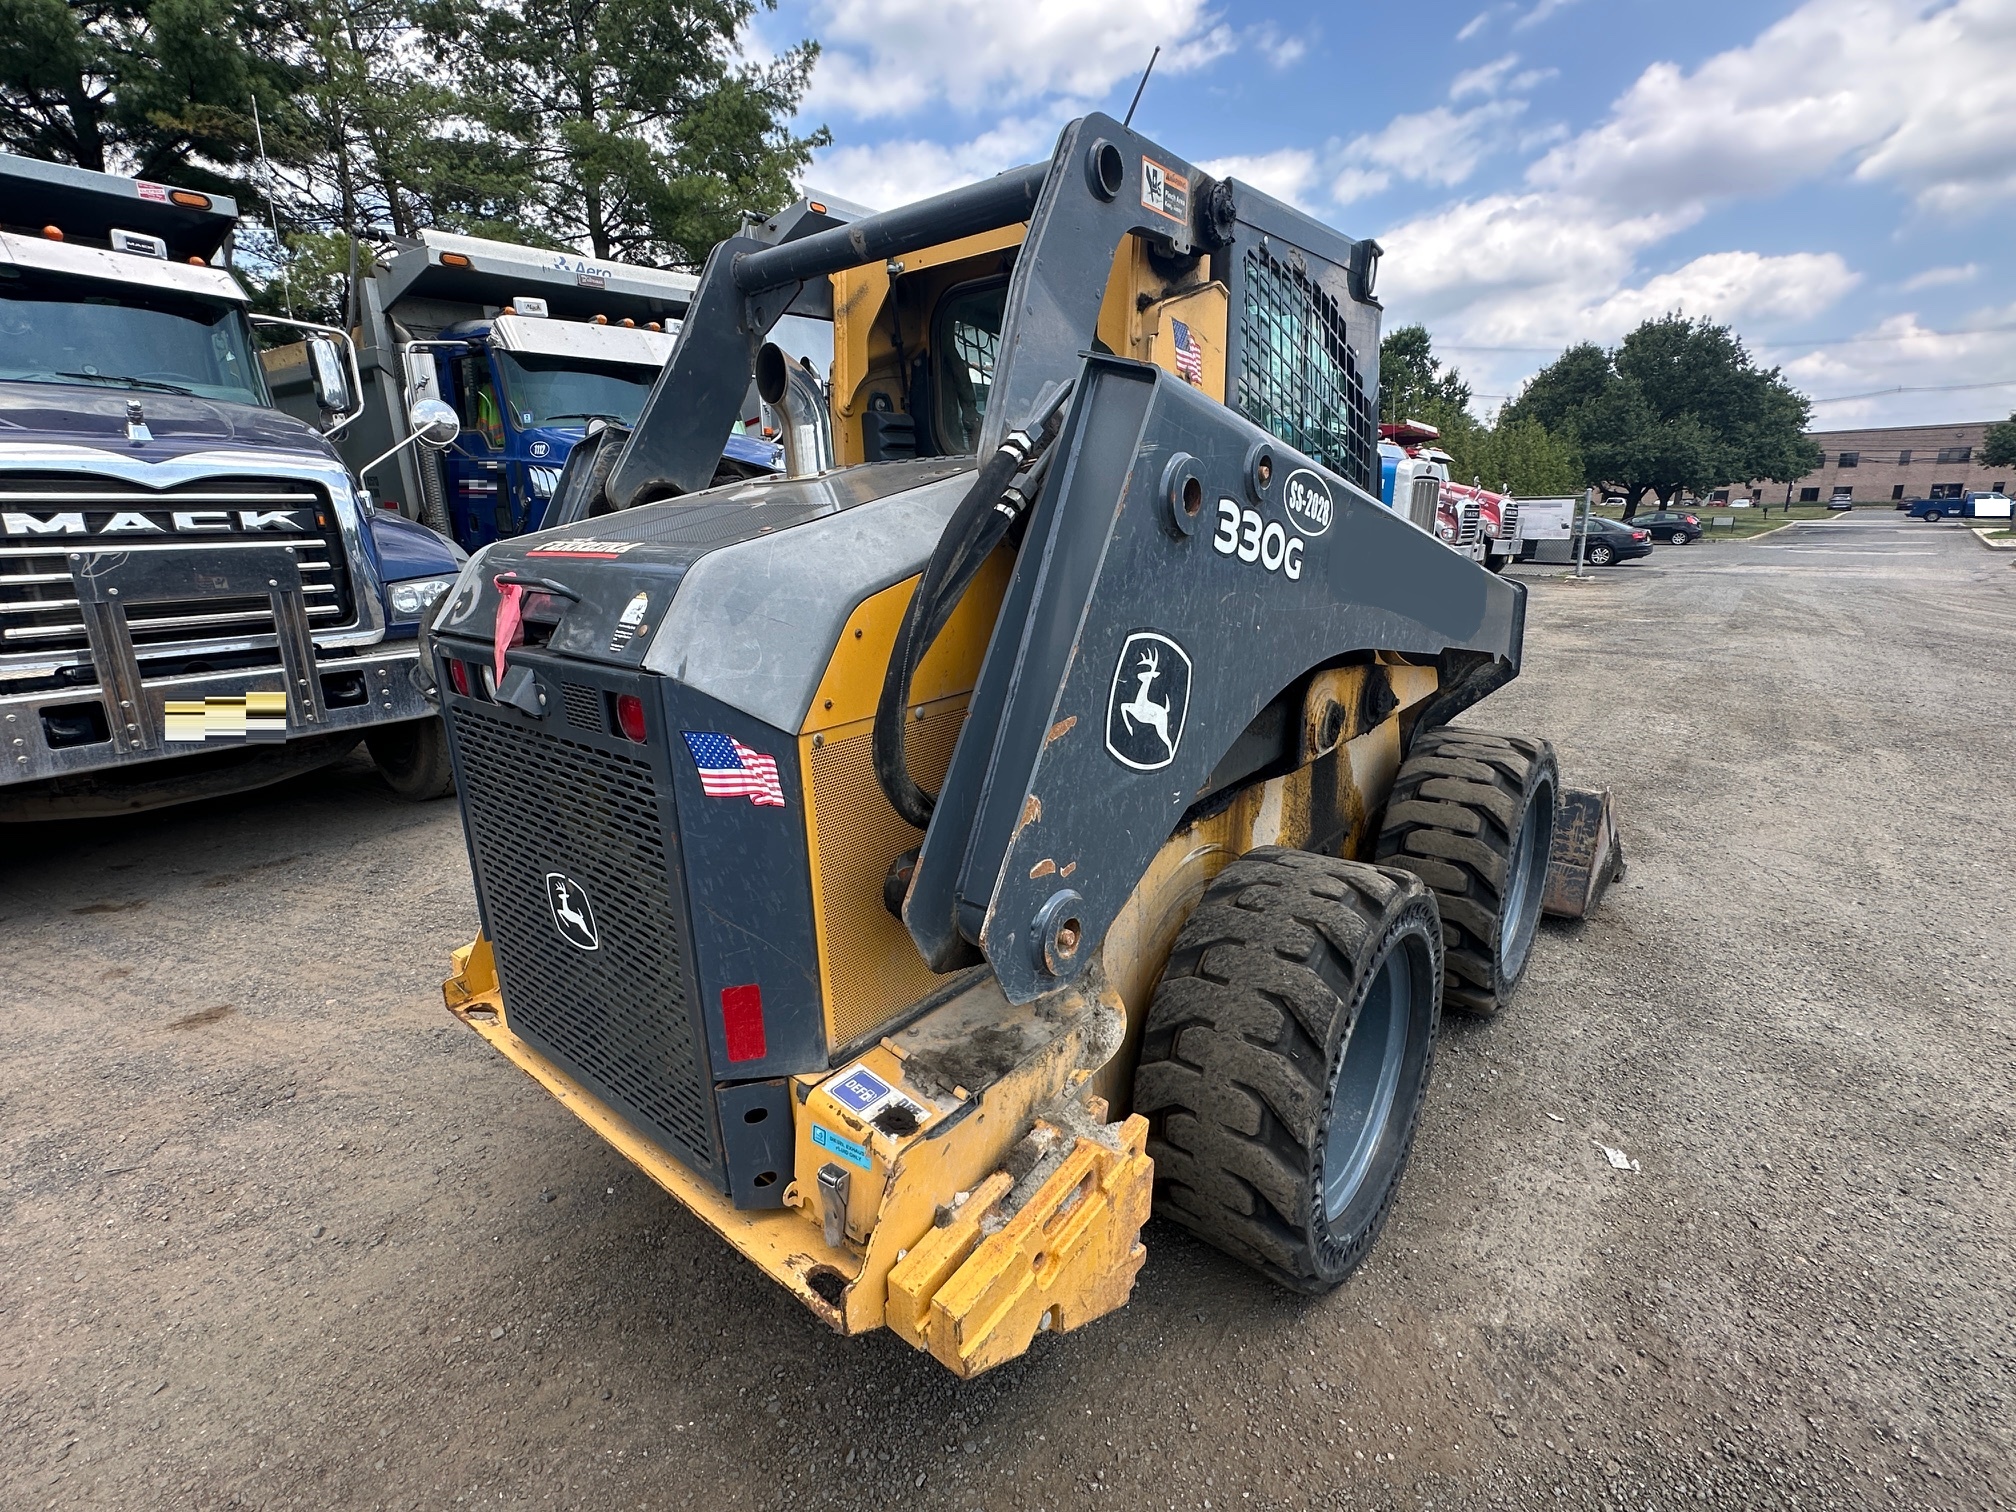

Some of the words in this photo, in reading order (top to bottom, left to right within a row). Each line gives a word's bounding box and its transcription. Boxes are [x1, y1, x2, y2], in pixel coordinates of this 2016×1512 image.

[126, 241, 154, 250] MACK
[575, 261, 612, 278] Aero
[533, 444, 546, 455] 1112
[1289, 480, 1330, 527] SS-2028
[1, 511, 304, 535] MACK
[1213, 498, 1305, 581] 330G
[844, 1079, 866, 1099] DEF
[835, 1145, 849, 1156] FLUID
[849, 1151, 862, 1162] ONLY
